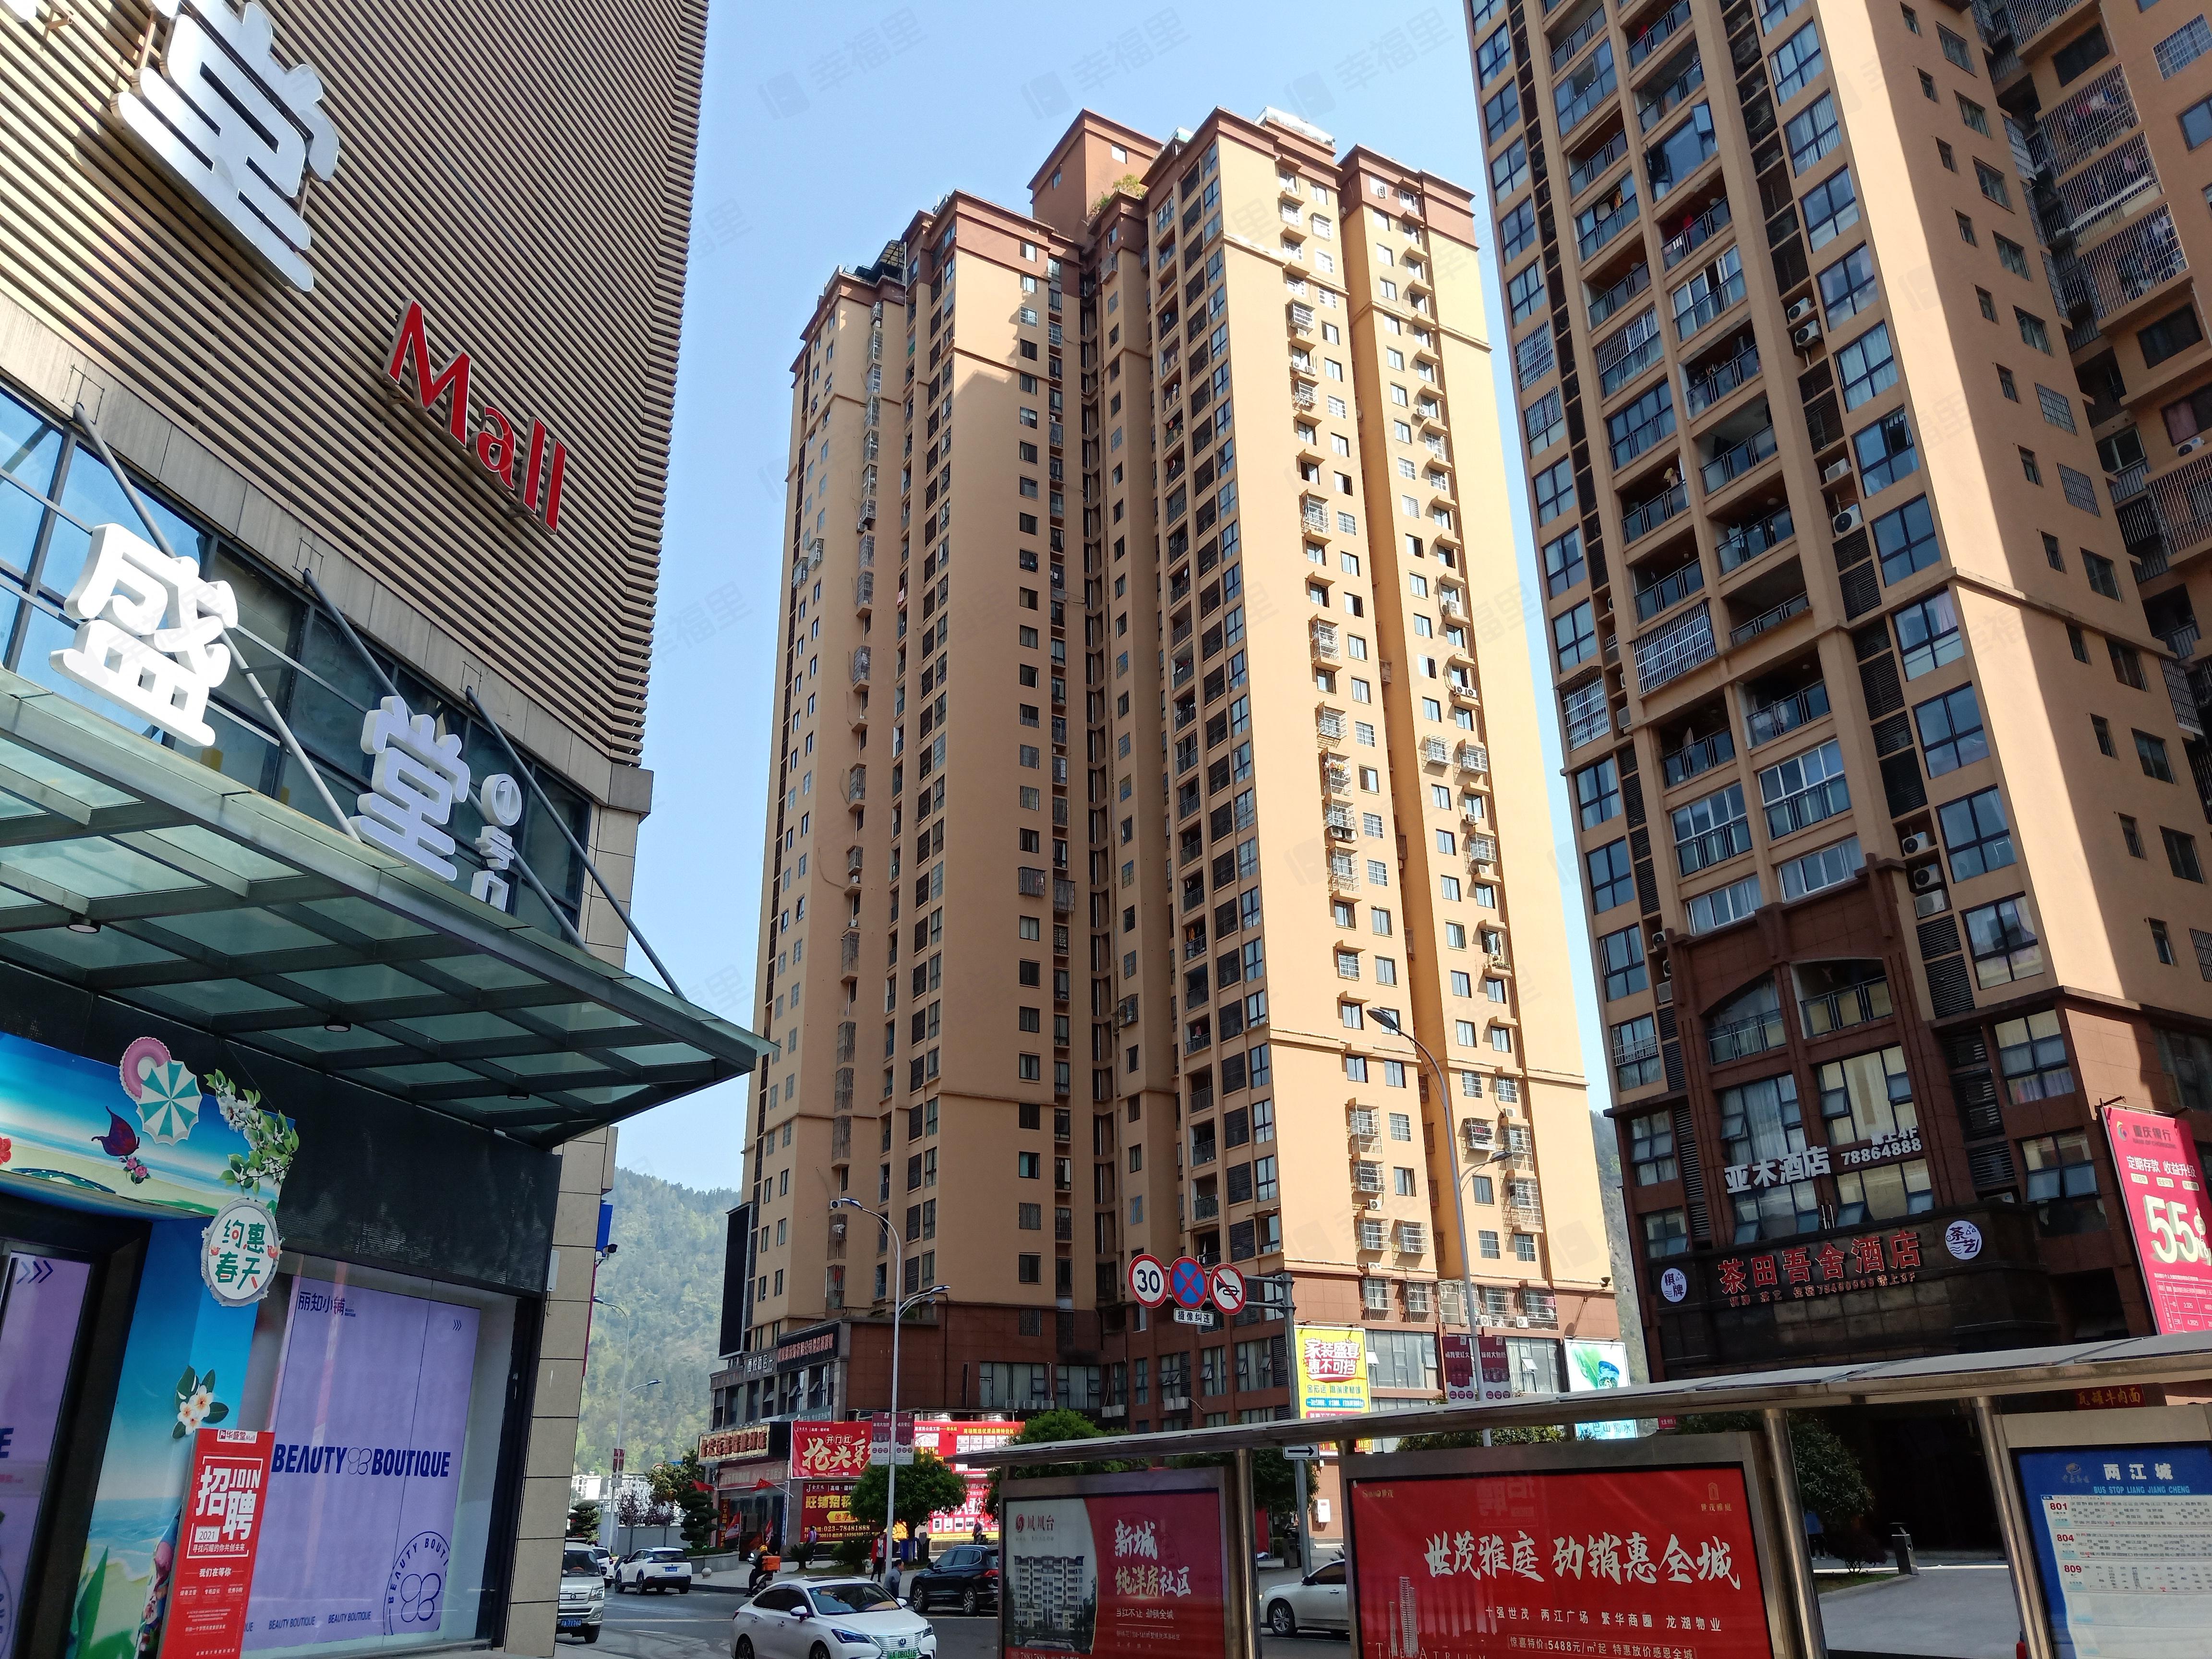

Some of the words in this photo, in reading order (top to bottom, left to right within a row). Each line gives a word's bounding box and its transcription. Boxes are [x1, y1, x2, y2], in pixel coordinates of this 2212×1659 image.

[385, 299, 567, 534] Mall
[2133, 1125, 2171, 1142] 重庆银行
[1841, 1138, 1922, 1166] 78864888
[2126, 1155, 2161, 1173] 定期存款
[2163, 1160, 2197, 1178] 收益升级
[215, 1251, 261, 1290] 春天
[1718, 1230, 1921, 1295] 茶田吾舍酒店
[1137, 1269, 1160, 1294] 30
[297, 1291, 346, 1316] 丽知小铺
[1178, 1310, 1211, 1324] 摄像纠违
[1304, 1338, 1360, 1359] 家装盛宴
[1308, 1358, 1357, 1375] 惠不可挡
[1593, 1422, 1632, 1434] 巴山蜀水
[271, 1444, 348, 1474] BEAUTY
[371, 1448, 451, 1478] BOUTIQUE
[229, 1469, 262, 1489] JOIN
[2103, 1463, 2174, 1481] 两江城
[2093, 1486, 2107, 1494] BUS
[2108, 1486, 2125, 1494] STOP
[2127, 1486, 2145, 1494] LIANG
[2147, 1486, 2166, 1494] JIANG
[2168, 1485, 2190, 1494] CHENG
[195, 1465, 257, 1540] 招聘
[2050, 1503, 2068, 1511] 801
[199, 1531, 215, 1540] 2021
[1114, 1519, 1158, 1560] 新城
[2056, 1534, 2075, 1542] 804
[1423, 1530, 1545, 1583] 世茂雅庭
[1551, 1531, 1741, 1590] 劲销惠全城
[2064, 1564, 2082, 1573] 809
[199, 1567, 232, 1577] 我们在等你
[1115, 1564, 1192, 1599] 纯洋房社区
[268, 1619, 289, 1630] BEAUTY
[289, 1616, 315, 1628] BOUTIQUE
[328, 1613, 347, 1624] BEAUTY
[347, 1611, 372, 1622] BOUTIQUE
[1116, 1608, 1143, 1618] 当红不让
[1485, 1605, 1529, 1621] 十强世茂
[1540, 1608, 1589, 1624] 两江广场
[1601, 1611, 1653, 1628] 繁华商圈
[1665, 1614, 1722, 1632] 龙湖物业
[1612, 1644, 1694, 1659] 特惠放价感恩全城
